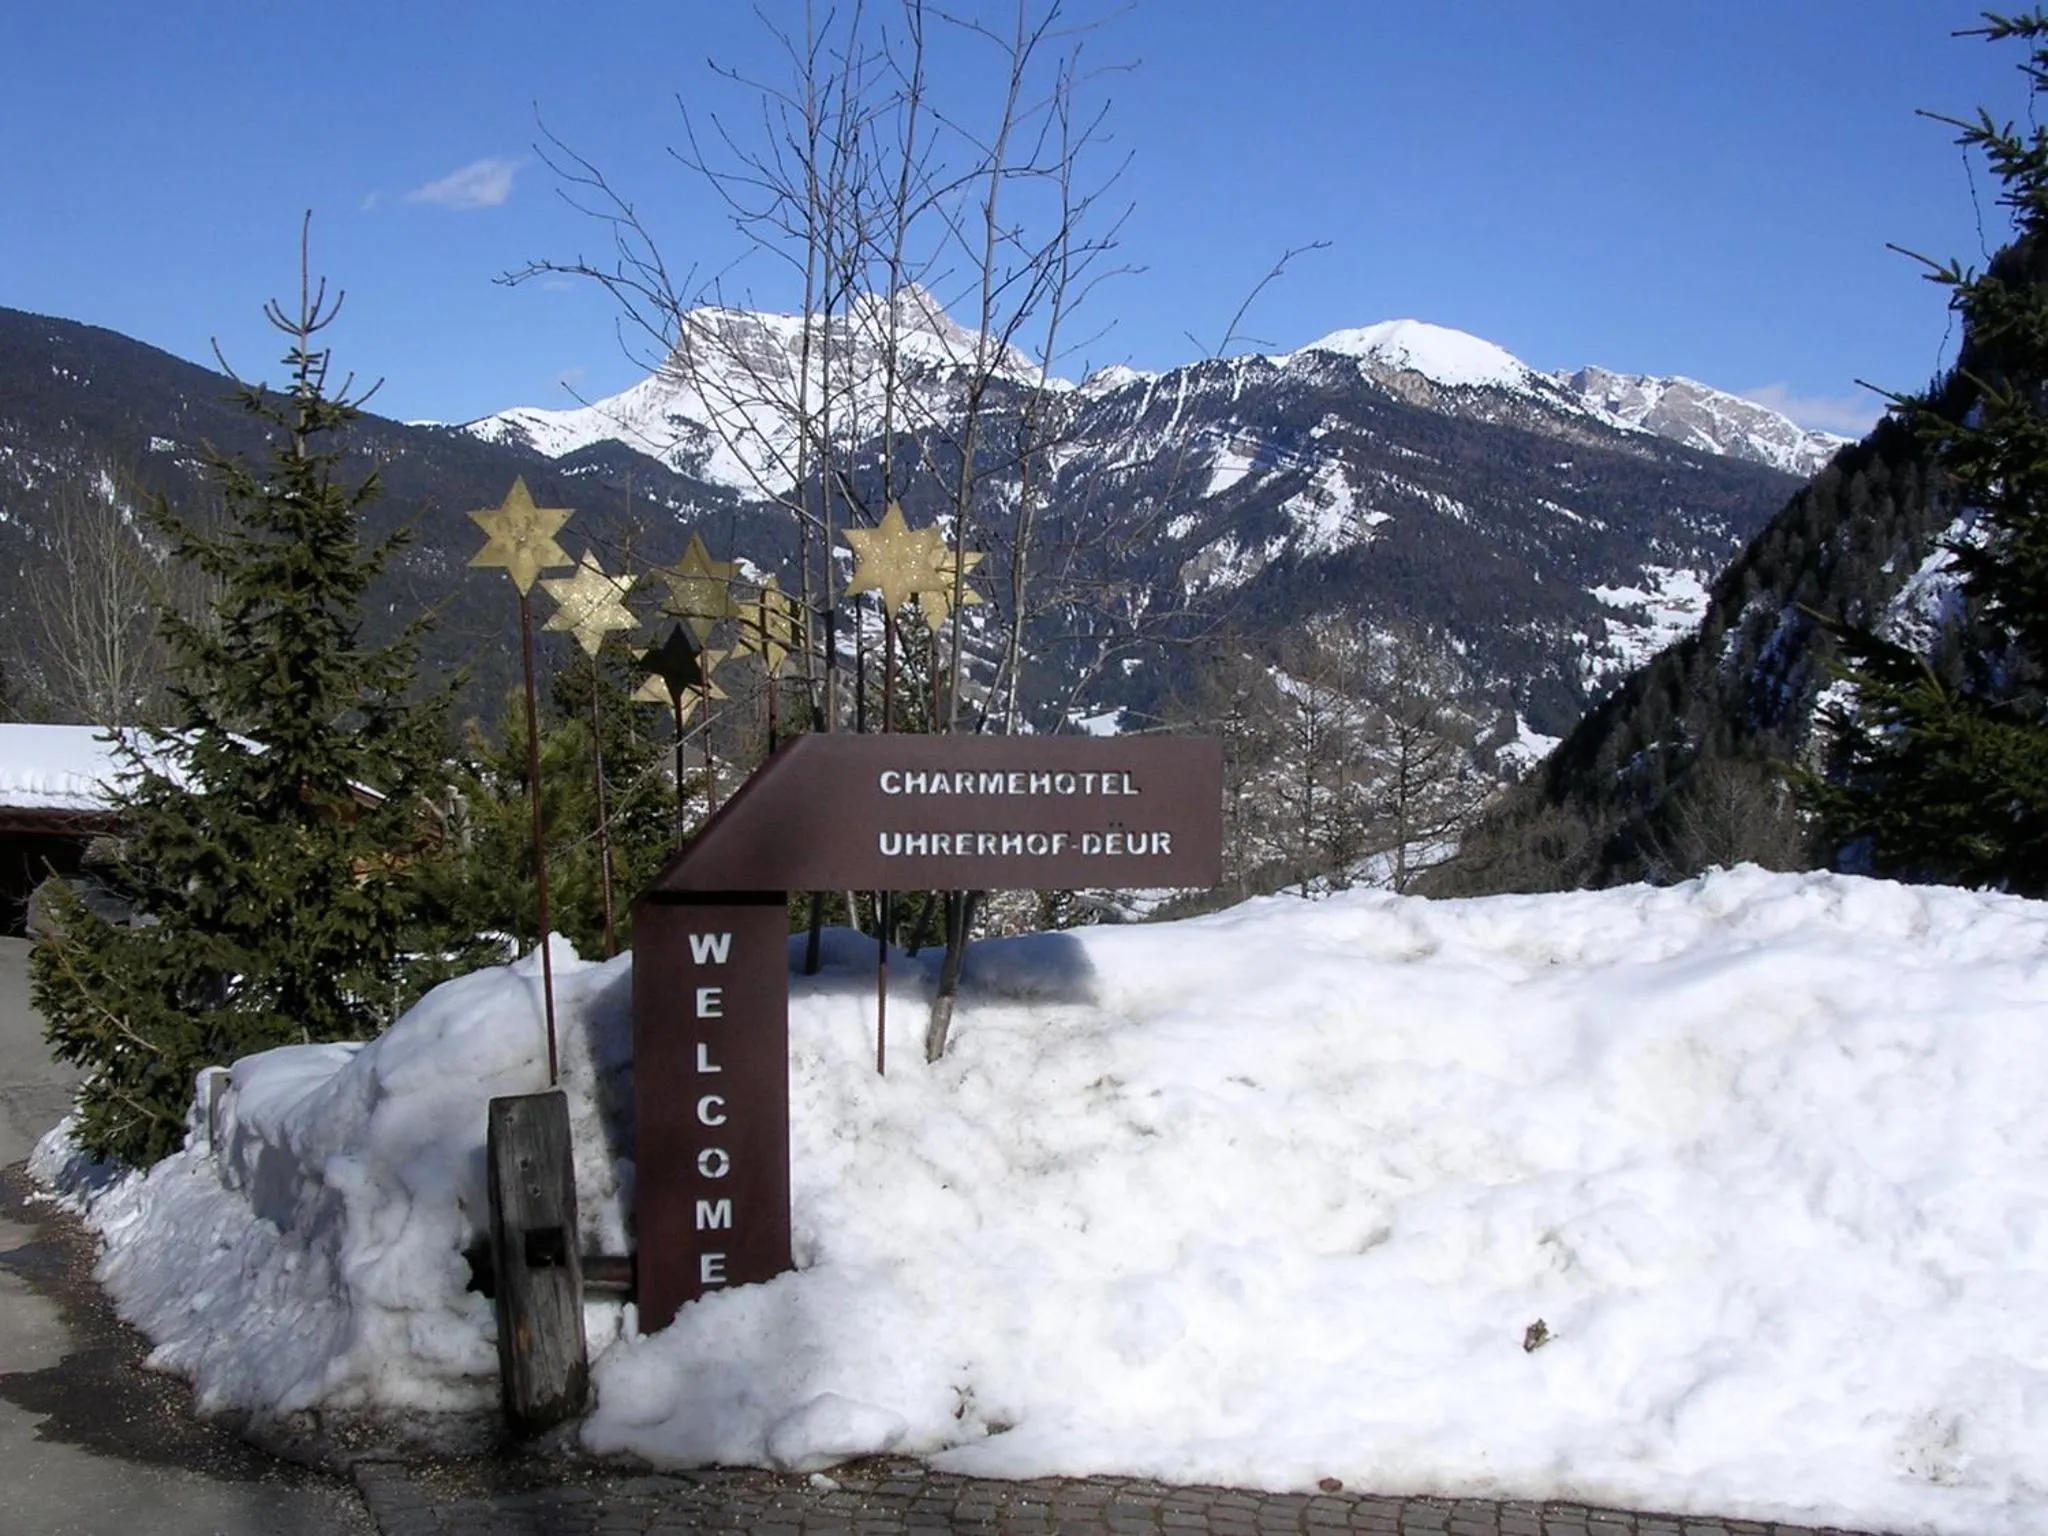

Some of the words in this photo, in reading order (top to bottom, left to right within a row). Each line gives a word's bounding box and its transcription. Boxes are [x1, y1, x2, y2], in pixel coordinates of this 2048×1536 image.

[879, 770, 1140, 796] CHARMEHOTEL
[879, 823, 1173, 856] UHRERHOF-DËUR
[688, 932, 732, 1284] WELCOME
